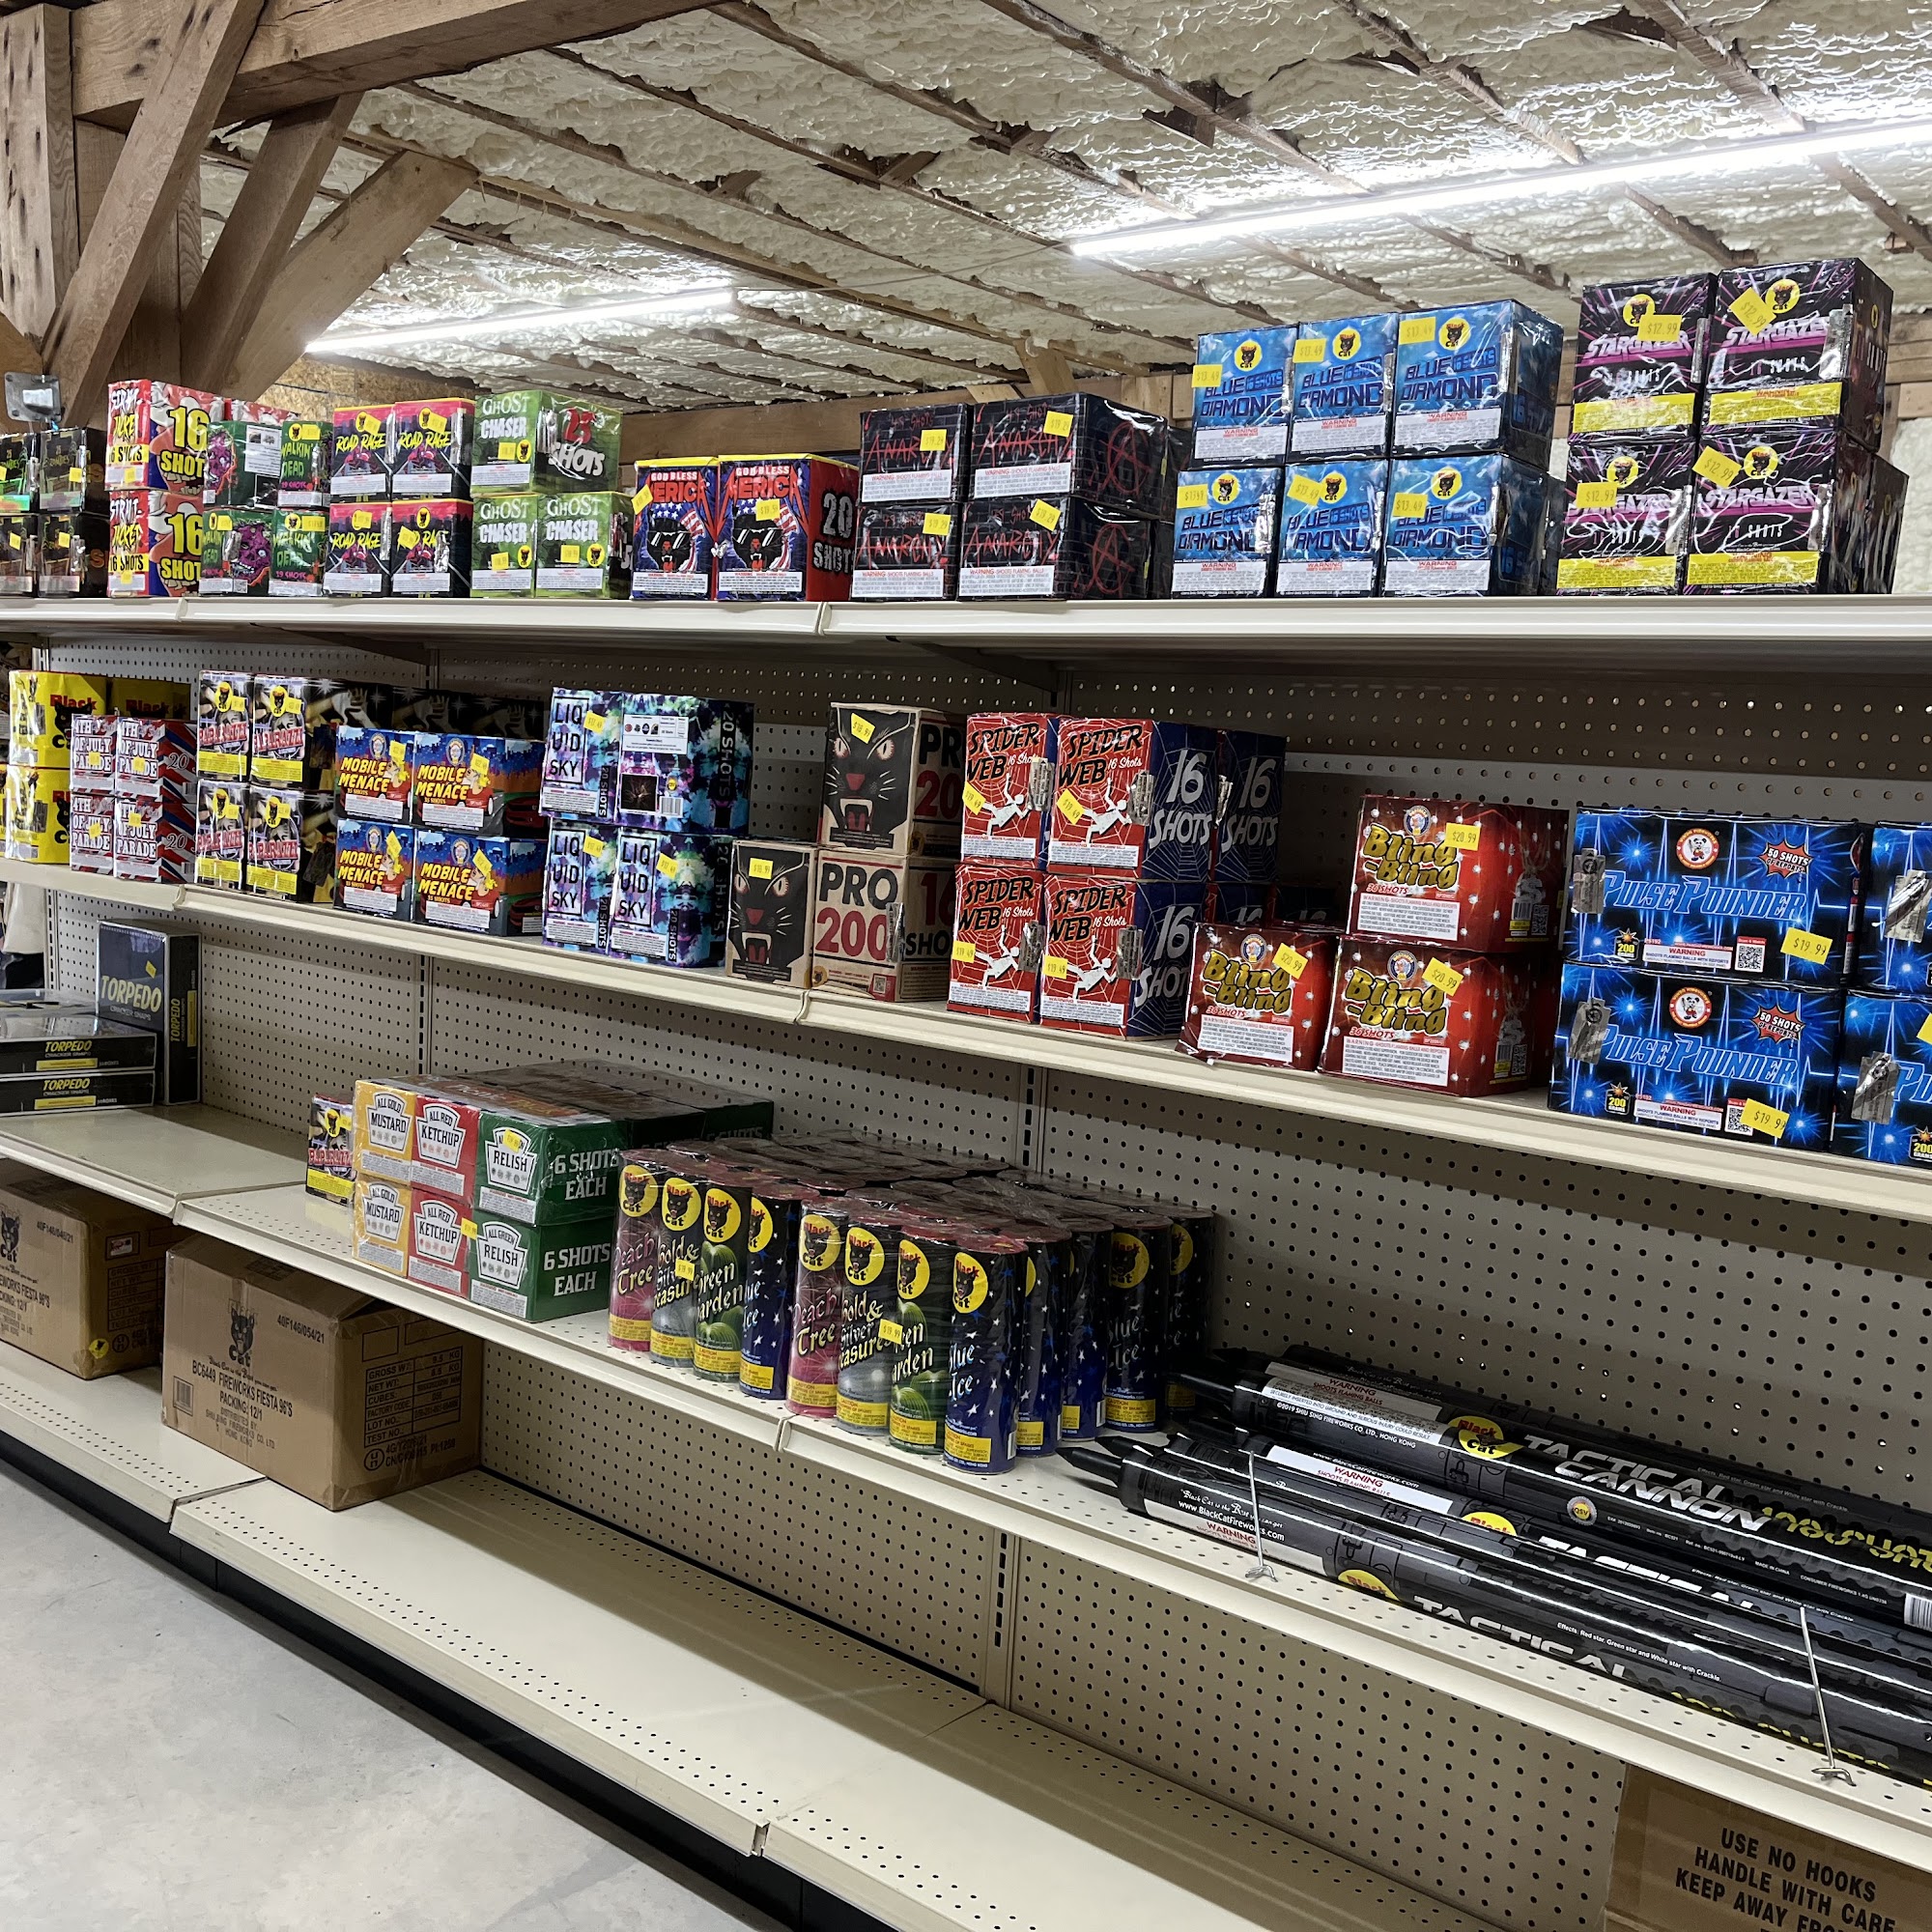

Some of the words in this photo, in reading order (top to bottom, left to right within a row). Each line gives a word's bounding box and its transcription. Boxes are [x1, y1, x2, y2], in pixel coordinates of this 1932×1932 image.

[1740, 301, 1767, 328] $12.99
[1646, 323, 1678, 335] $12.99
[1303, 365, 1344, 389] BLUE
[1405, 356, 1452, 382] BLUE
[1206, 377, 1246, 398] BLUE
[1298, 383, 1383, 409] DIAMOND
[1402, 373, 1500, 401] DIAMOND
[483, 393, 529, 415] GHOST
[1201, 394, 1287, 418] DIAMOND
[169, 406, 211, 450] 16
[480, 417, 526, 439] CHASER
[336, 437, 358, 452] ROAD
[361, 434, 385, 451] RAGE
[398, 433, 423, 448] ROAD
[426, 431, 451, 448] RAGE
[549, 444, 605, 476] SHOTS
[736, 468, 754, 476] GOD
[755, 466, 789, 475] BLESS
[1704, 458, 1735, 481] $12.99
[651, 471, 668, 482] GOD
[670, 470, 697, 481] BLESS
[547, 495, 599, 517] GHOST
[1397, 500, 1423, 512] $13.49
[1585, 491, 1614, 502] $12.99
[1707, 485, 1815, 509] STARGAZER
[480, 498, 528, 520] GHOST
[823, 494, 853, 538] 20
[1182, 510, 1223, 530] BLUE
[1289, 509, 1326, 530] BLUE
[331, 534, 356, 551] ROAD
[358, 532, 382, 549] RAGE
[479, 522, 527, 543] CHASER
[546, 520, 599, 542] CHASER
[120, 554, 143, 572] SHOTS
[50, 695, 97, 709] Black
[554, 702, 582, 726] LIQ
[87, 738, 111, 754] JULY
[552, 732, 580, 753] UID
[969, 723, 1041, 754] SPIDER
[1068, 724, 1143, 758] SPIDER
[132, 744, 157, 759] JULY
[168, 753, 189, 770] 20
[1117, 755, 1143, 769] Shots
[340, 757, 387, 777] MOBILE
[417, 765, 467, 783] MOBILE
[550, 759, 579, 779] SKY
[1060, 759, 1107, 788] WEB
[1166, 749, 1208, 805] 16
[338, 773, 390, 793] MENACE
[415, 781, 469, 801] MENACE
[1237, 756, 1273, 810] 16
[73, 798, 91, 813] 4TH
[599, 780, 610, 817] SHOTS
[1150, 810, 1212, 849] SHOTS
[1221, 816, 1279, 854] SHOTS
[1452, 831, 1477, 844] $20.99
[71, 833, 110, 851] PARADE
[117, 840, 156, 859] PARADE
[166, 834, 187, 850] 20
[554, 835, 581, 858] LIQ
[1363, 823, 1460, 865] Bling
[340, 850, 383, 869] MOBILE
[622, 841, 651, 866] LIQ
[1767, 847, 1779, 859] 50
[1779, 851, 1810, 867] SHOTS
[338, 867, 386, 886] MENACE
[420, 863, 471, 884] MOBILE
[552, 864, 579, 885] UID
[620, 870, 649, 894] UID
[418, 879, 475, 901] MENACE
[819, 863, 898, 910] PRO
[964, 876, 1036, 905] SPIDER
[1604, 870, 1678, 912] PULSE
[1677, 874, 1808, 922] POUNDER
[552, 891, 578, 910] SKY
[618, 899, 647, 920] SKY
[1055, 884, 1127, 915] SPIDER
[958, 907, 1002, 932] WEB
[1011, 906, 1035, 918] Shots
[1049, 916, 1093, 943] WEB
[668, 924, 678, 960] SHOTS
[1617, 943, 1635, 953] 200
[1668, 947, 1706, 957] WARNING
[1793, 938, 1828, 956] $19.99
[1203, 951, 1291, 992] Bling
[1432, 969, 1459, 989] $20.99
[100, 975, 162, 1013] TORPEDO
[1347, 969, 1446, 1012] Bling
[171, 998, 181, 1042] TORPEDO
[1365, 1028, 1395, 1039] SHOTS
[44, 1039, 93, 1053] TORPEDO
[1669, 1034, 1800, 1087] POUNDER
[43, 1077, 91, 1092] TORPEDO
[377, 1096, 386, 1109] ALL
[387, 1098, 402, 1112] GOLD
[1608, 1097, 1627, 1108] 200
[1660, 1103, 1697, 1117] WARNING
[370, 1112, 407, 1133] MUSTARD
[1753, 1110, 1787, 1129] $19.99
[421, 1126, 459, 1148] KETCHUP
[494, 1151, 527, 1172] RELISH
[554, 1157, 564, 1175] 6
[567, 1150, 619, 1173] SHOTS
[564, 1177, 608, 1202] EACH
[707, 1194, 733, 1210] Black
[419, 1221, 458, 1244] KETCHUP
[484, 1243, 519, 1266] RELISH
[544, 1252, 554, 1271] 6
[557, 1242, 611, 1267] SHOTS
[803, 1252, 824, 1267] Cat
[553, 1270, 598, 1296] EACH
[617, 1265, 653, 1295] Tree
[798, 1323, 835, 1355] Tree
[192, 1359, 216, 1382] BC6449
[219, 1372, 255, 1401] FIREWORKS
[256, 1388, 278, 1411] FIESTA
[1329, 1378, 1377, 1397] WARNING
[219, 1391, 249, 1414] PACKING:
[1322, 1415, 1353, 1431] FIREWORKS
[1399, 1438, 1417, 1450] KONG
[1457, 1418, 1498, 1440] Black
[1466, 1437, 1498, 1456] Cat
[1334, 1465, 1384, 1489] WARNING
[1524, 1435, 1725, 1501] TACTICAL
[1554, 1461, 1773, 1532] CANNON
[1207, 1520, 1256, 1546] WARNING
[1580, 1630, 1592, 1639] Red
[1606, 1637, 1626, 1651] Green
[1651, 1652, 1668, 1662] White
[1721, 1828, 1759, 1860] USE
[1768, 1845, 1797, 1872] NO
[1805, 1860, 1876, 1903] HOOKS
[1675, 1867, 1725, 1902] KEEP
[1733, 1891, 1788, 1927] AWAY
[1694, 1846, 1772, 1893] HANDLE
[1782, 1879, 1832, 1917] WITH
[1841, 1903, 1896, 1932] CARE
